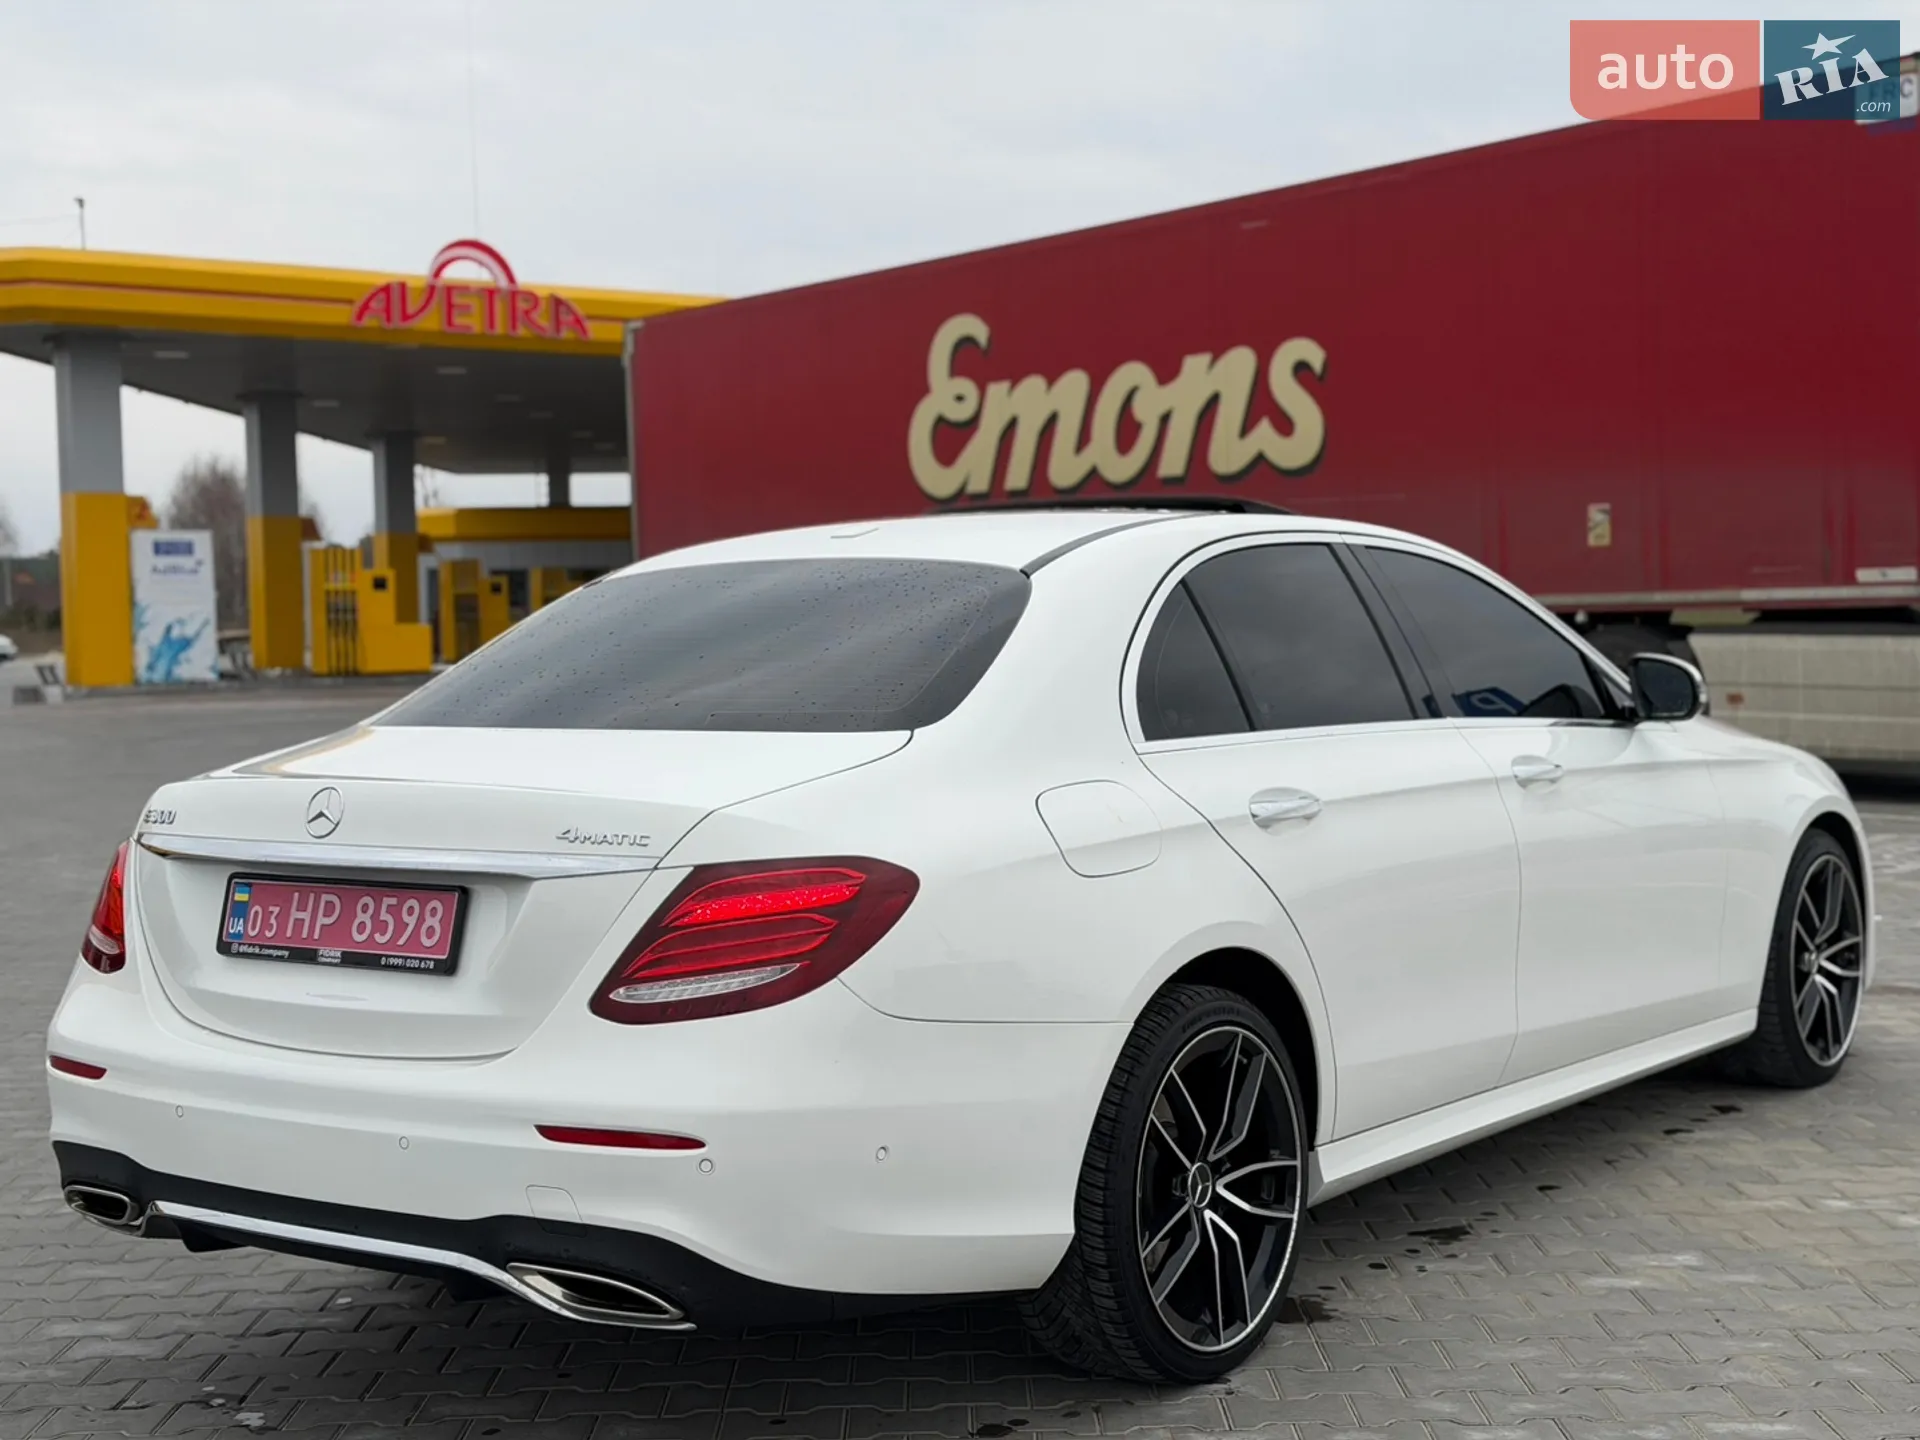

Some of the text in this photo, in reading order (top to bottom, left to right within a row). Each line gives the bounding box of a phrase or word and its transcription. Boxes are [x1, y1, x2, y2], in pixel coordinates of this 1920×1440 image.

[353, 279, 593, 341] AVETRA
[908, 313, 1327, 500] Emons
[556, 827, 651, 847] 4MATIC
[229, 917, 244, 934] UA
[247, 892, 444, 948] 03 HP 8598
